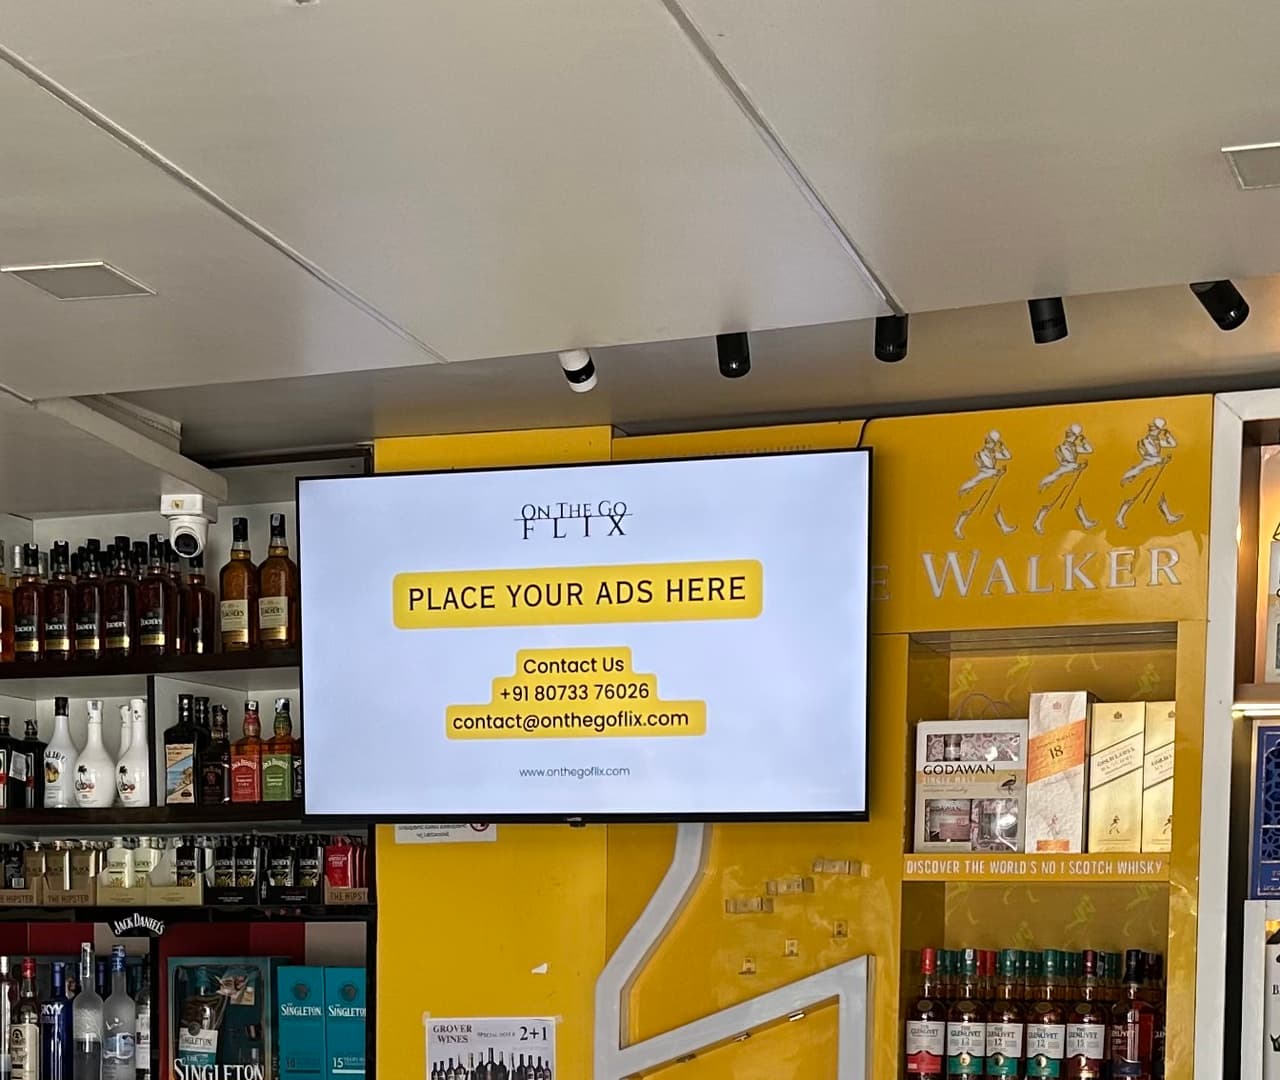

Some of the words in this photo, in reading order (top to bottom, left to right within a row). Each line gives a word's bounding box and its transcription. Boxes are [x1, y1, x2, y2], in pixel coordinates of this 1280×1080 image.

[522, 515, 627, 540] FLIX
[921, 547, 1182, 600] WALKER
[408, 585, 496, 611] PLACE
[506, 582, 584, 608] YOUR
[596, 580, 653, 605] ADS
[666, 576, 746, 602] HERE
[523, 657, 597, 675] Contact
[602, 657, 624, 672] Us
[500, 686, 528, 702] +91
[534, 684, 588, 701] 80733
[594, 683, 649, 700] 76026
[453, 711, 689, 732] contact@onthegoflix.com
[1049, 745, 1064, 760] 18
[520, 766, 630, 780] www.onthegoflix.com
[923, 764, 995, 775] GODAWAN
[906, 860, 960, 874] DISCOVER
[965, 860, 985, 874] THE
[1070, 861, 1113, 874] SCOTCH
[1117, 861, 1163, 874] WHISKY
[114, 917, 134, 936] JACK
[134, 913, 166, 935] DANIEL'S
[281, 1004, 321, 1017] SINGLETON
[432, 1024, 472, 1033] GROVER
[519, 1026, 548, 1041] 2+1
[437, 1035, 468, 1044] WINES
[332, 1056, 344, 1068] 15
